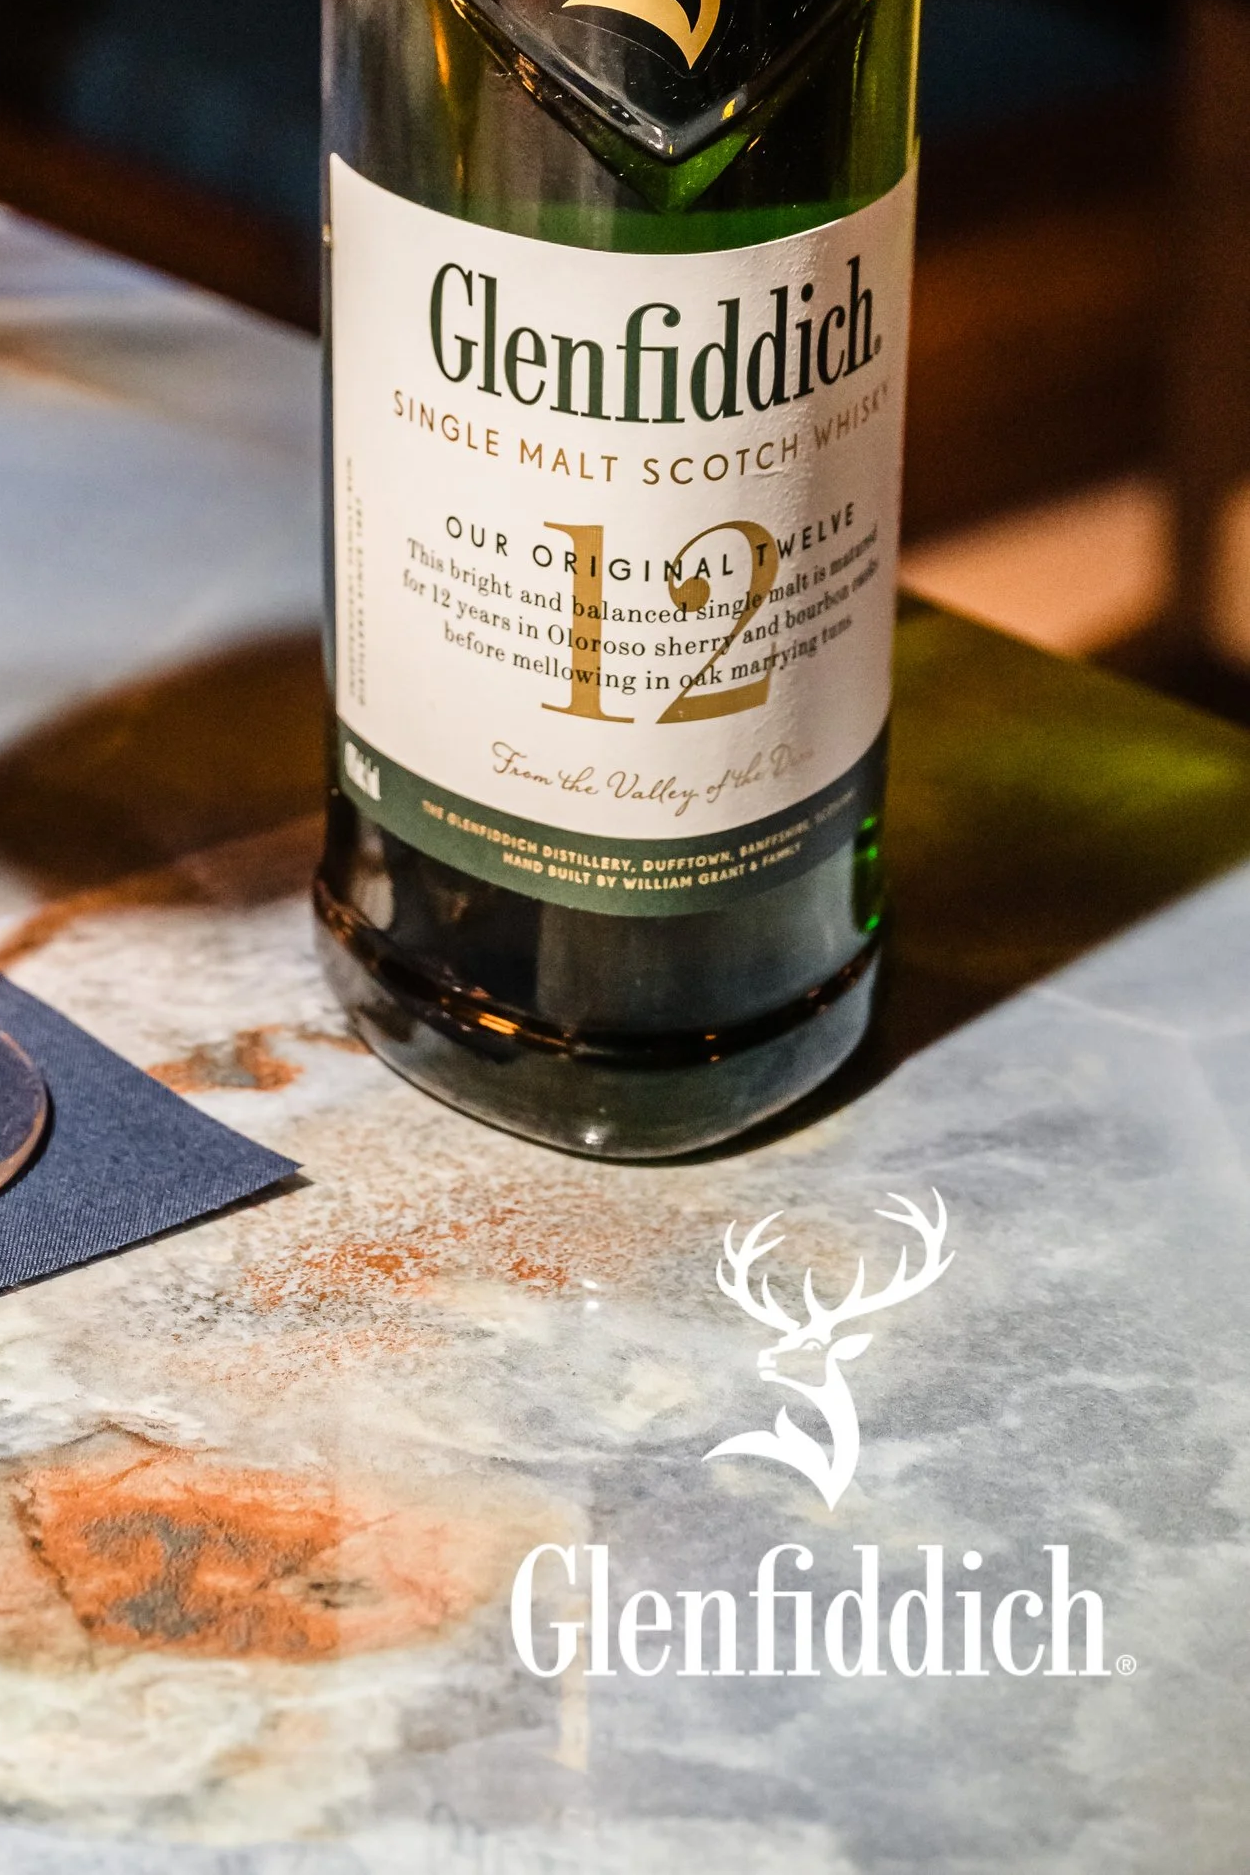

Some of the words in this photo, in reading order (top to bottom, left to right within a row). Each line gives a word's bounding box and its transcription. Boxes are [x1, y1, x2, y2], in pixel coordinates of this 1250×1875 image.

[430, 254, 874, 424] Glenfiddich
[393, 390, 499, 457] SINGLE
[520, 438, 618, 482] MALT
[642, 433, 798, 485] SCOTCH
[406, 537, 444, 573] This
[450, 558, 513, 597] bright
[520, 592, 562, 612] and
[572, 595, 687, 623] balanced
[696, 590, 762, 620] single
[769, 572, 808, 603] malt
[813, 564, 826, 585] is
[446, 516, 508, 556] OUR
[532, 544, 734, 582] ORIGINAL
[756, 502, 854, 567] TWELVE
[402, 569, 426, 596] for
[433, 584, 450, 608] 12
[456, 598, 511, 631] years
[518, 616, 539, 639] in
[547, 624, 645, 657] Oloroso
[655, 636, 736, 656] sherry
[742, 615, 779, 644] and
[541, 520, 779, 724] 12
[444, 621, 505, 661] before
[513, 652, 636, 695] mellowing
[646, 670, 670, 689] in
[680, 664, 722, 687] oak
[731, 635, 818, 681] marrying
[492, 741, 552, 785] From
[558, 766, 598, 794] the
[607, 771, 698, 816] Valley
[707, 769, 728, 804] of
[728, 751, 762, 781] the
[447, 812, 538, 854] GLENFIDDICH
[542, 845, 637, 873] DISTILLERY,
[643, 849, 735, 873] DUFFTOWN,
[503, 852, 544, 874] HAND
[548, 864, 591, 885] BUILT
[596, 874, 617, 888] BY
[623, 876, 692, 890] WILLIAM
[698, 864, 745, 885] GRANT
